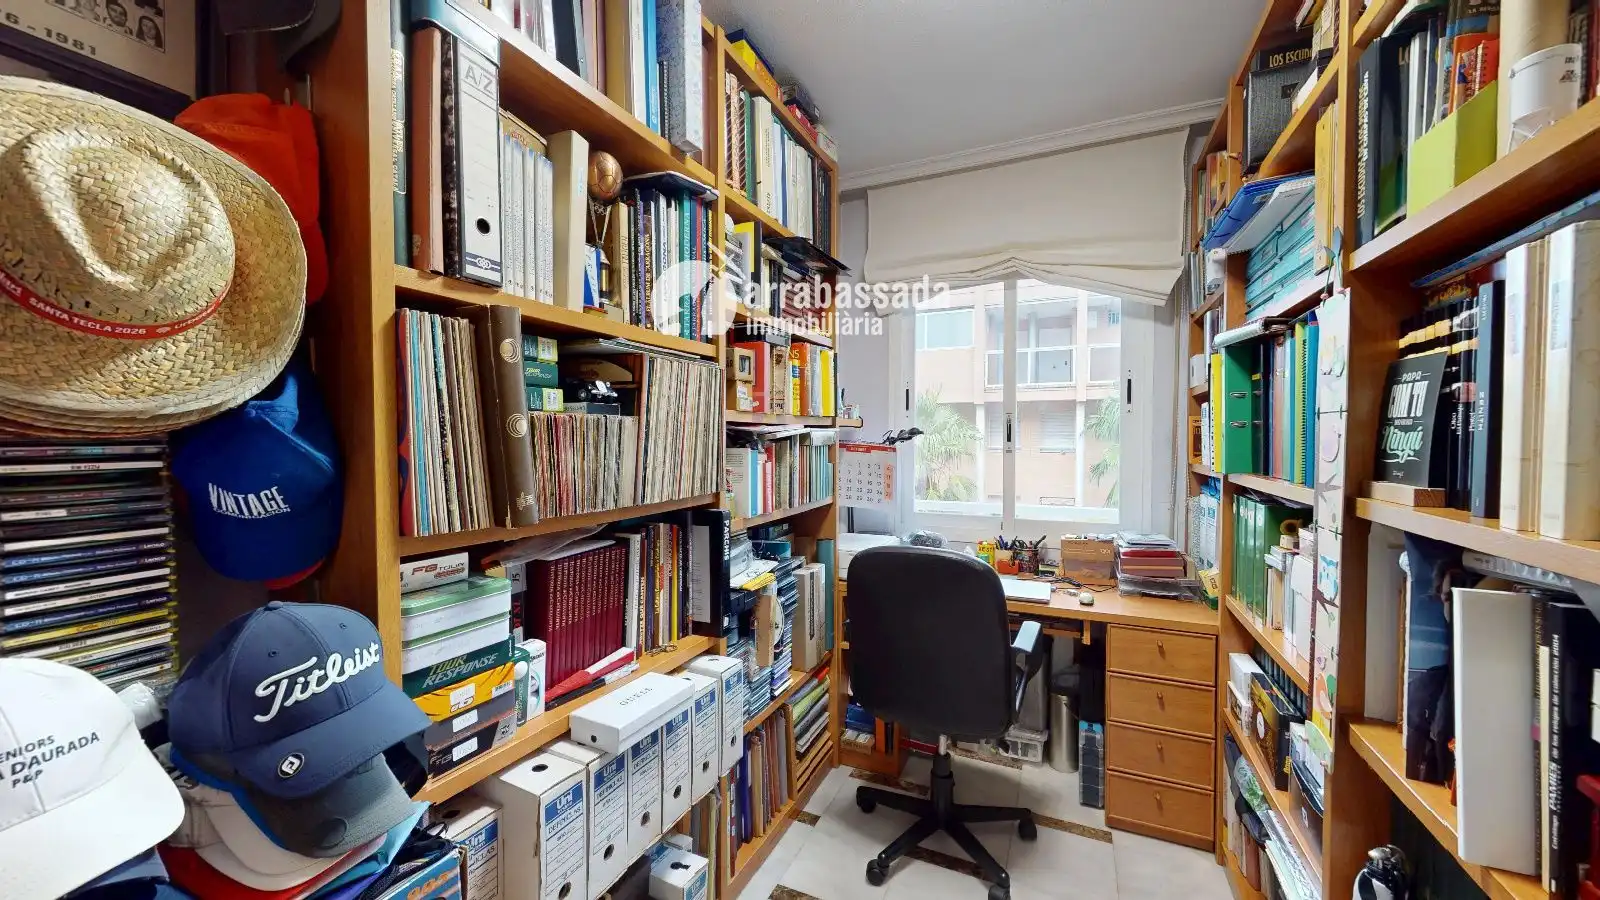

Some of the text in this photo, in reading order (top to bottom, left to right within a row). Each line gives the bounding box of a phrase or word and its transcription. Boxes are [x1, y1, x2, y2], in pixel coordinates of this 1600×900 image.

[43, 27, 98, 57] 1981
[1269, 53, 1285, 68] LOS
[464, 64, 496, 97] A/Z
[26, 296, 73, 325] SANTA
[70, 314, 113, 335] TECLA
[114, 326, 148, 337] 2026
[1387, 380, 1430, 419] COM TU
[1477, 391, 1485, 431] ZENITH
[1381, 424, 1424, 464] Ningú
[208, 482, 289, 517] VINTAGE
[253, 641, 381, 724] Titleist
[422, 652, 499, 688] RESPONSE
[428, 653, 468, 677] TOUR
[10, 731, 100, 776] DAURADA
[639, 735, 652, 748] Uni
[602, 761, 617, 777] Uni
[1548, 761, 1557, 811] PAMIES
[555, 790, 573, 810] Uni
